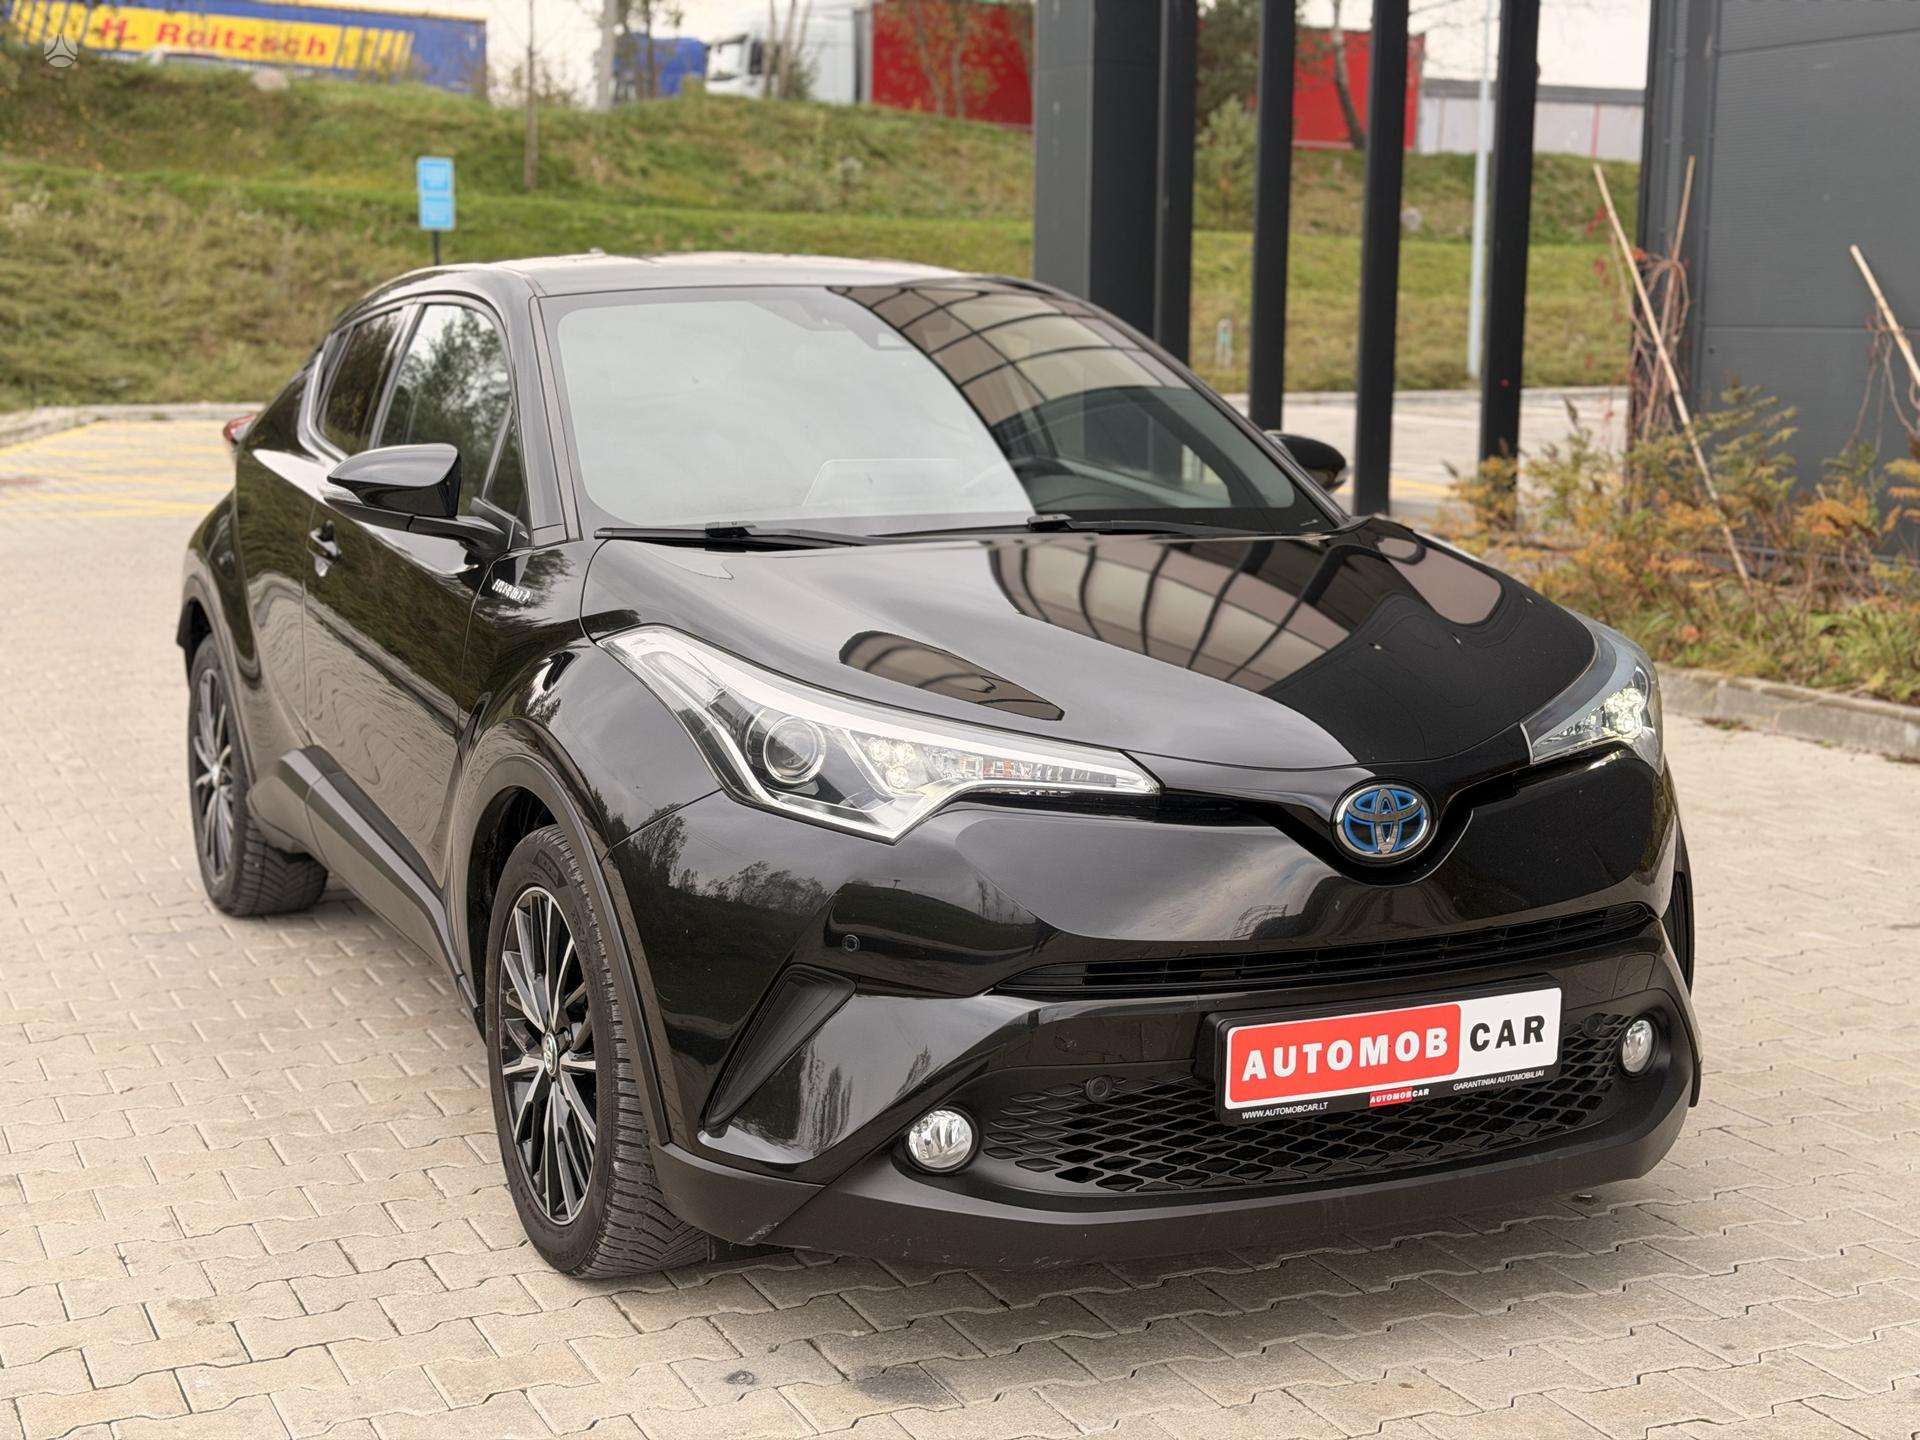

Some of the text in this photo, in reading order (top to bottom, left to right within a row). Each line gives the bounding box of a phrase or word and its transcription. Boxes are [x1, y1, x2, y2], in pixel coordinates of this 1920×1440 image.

[1469, 1015, 1546, 1052] CAR
[1453, 1070, 1545, 1091] GARANTINIAI AUTOMOBILIAI
[1241, 1102, 1329, 1119] WWW.AUTOMOBCAR.LT
